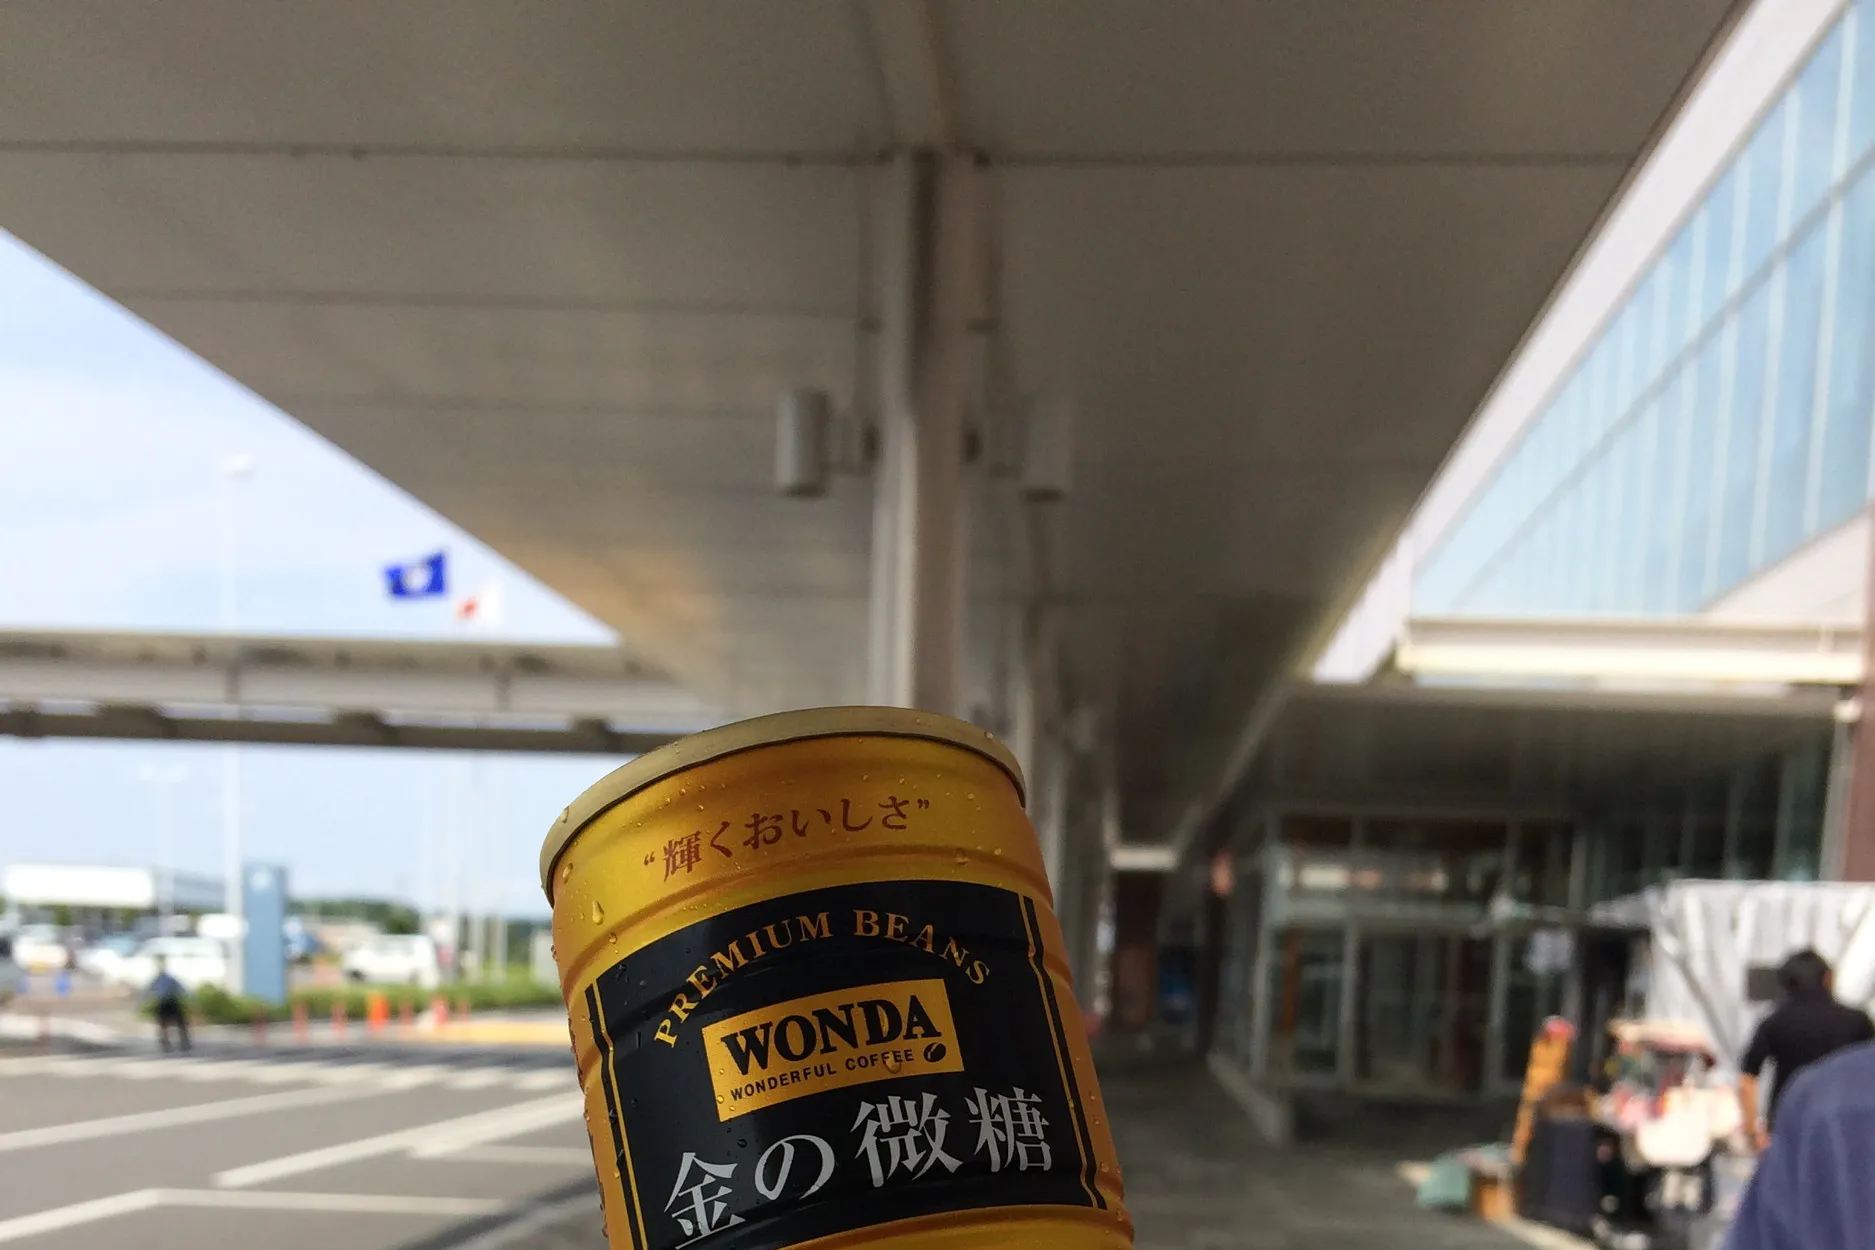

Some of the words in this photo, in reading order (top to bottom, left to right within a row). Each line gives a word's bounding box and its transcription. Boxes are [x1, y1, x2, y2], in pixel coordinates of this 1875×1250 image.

[654, 911, 833, 1048] PREMIUM
[853, 909, 990, 985] BEANS
[721, 995, 942, 1076] WONDA
[731, 1062, 837, 1101] WONDERFUL
[845, 1049, 914, 1072] COFFEE
[664, 1087, 1052, 1250] 金の微糖
